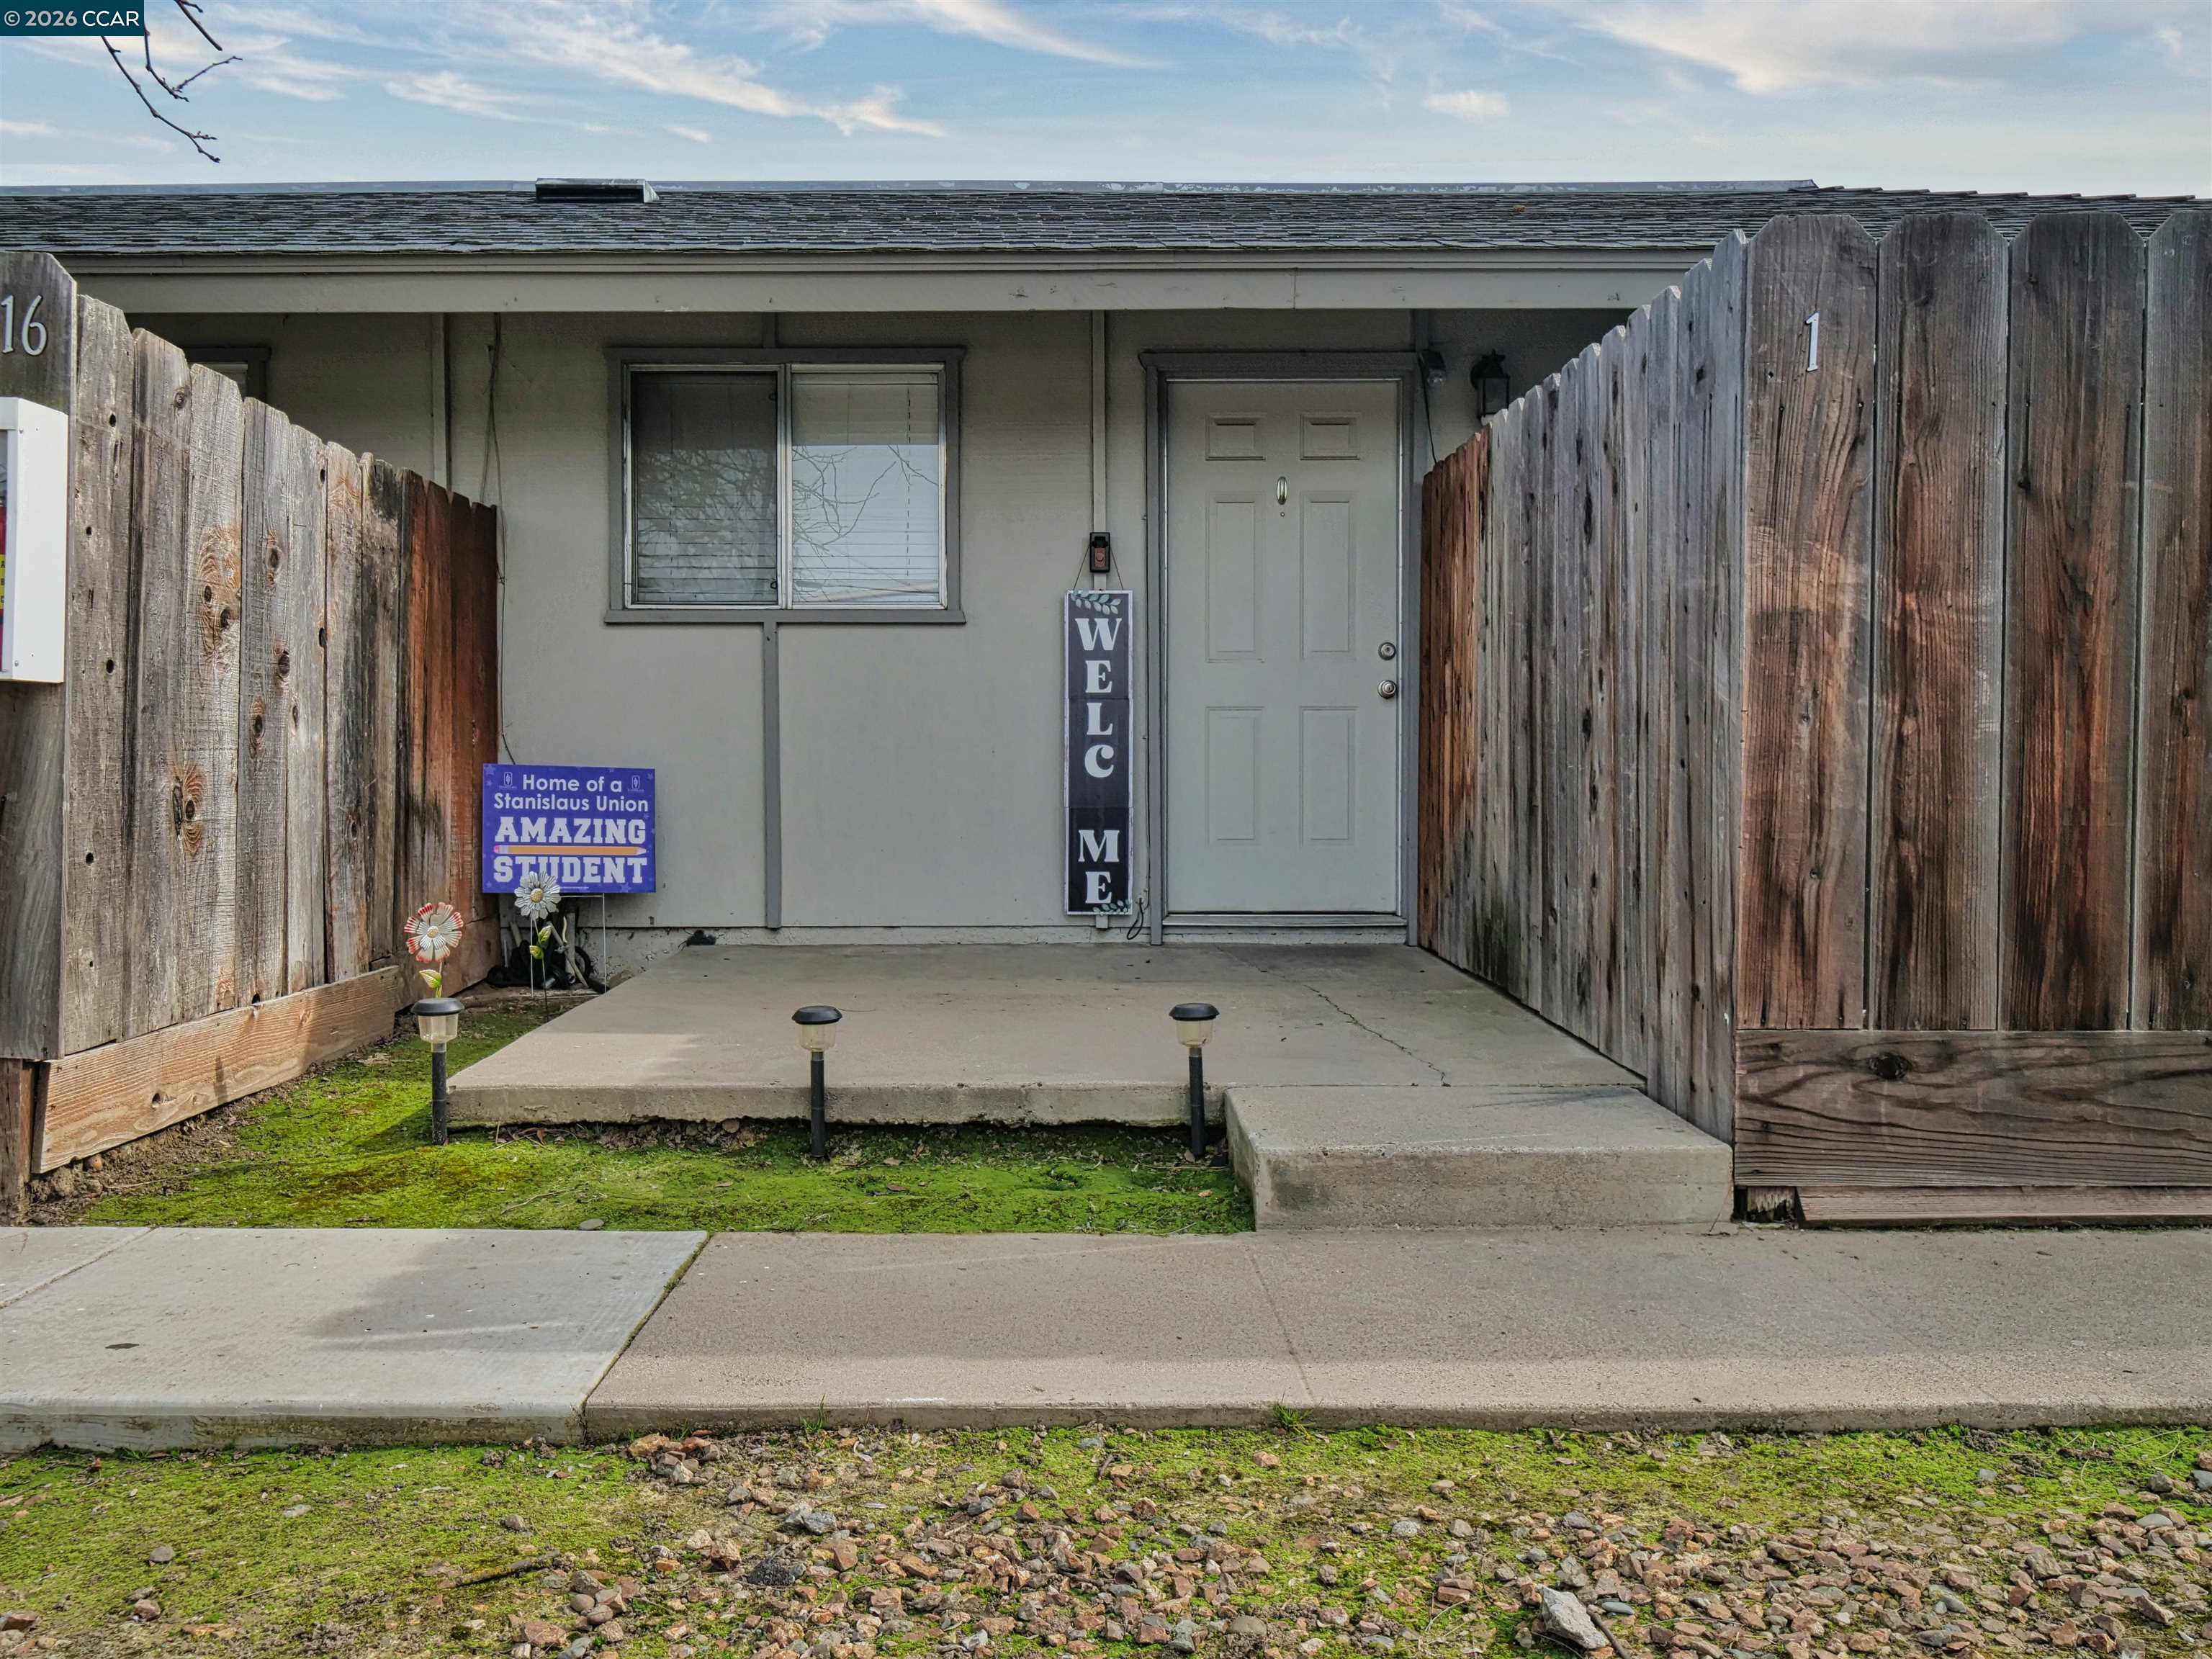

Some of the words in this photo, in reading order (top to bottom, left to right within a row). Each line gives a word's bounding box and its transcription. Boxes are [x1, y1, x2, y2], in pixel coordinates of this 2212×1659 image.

[1, 295, 48, 356] 16
[1804, 310, 1820, 372] 1
[522, 774, 580, 791] Home
[586, 776, 605, 792] of
[610, 781, 622, 792] a
[494, 792, 590, 811] Stanislaus
[596, 796, 649, 812] Union
[495, 817, 646, 844] AMAZING
[493, 855, 647, 884] STUDENT
